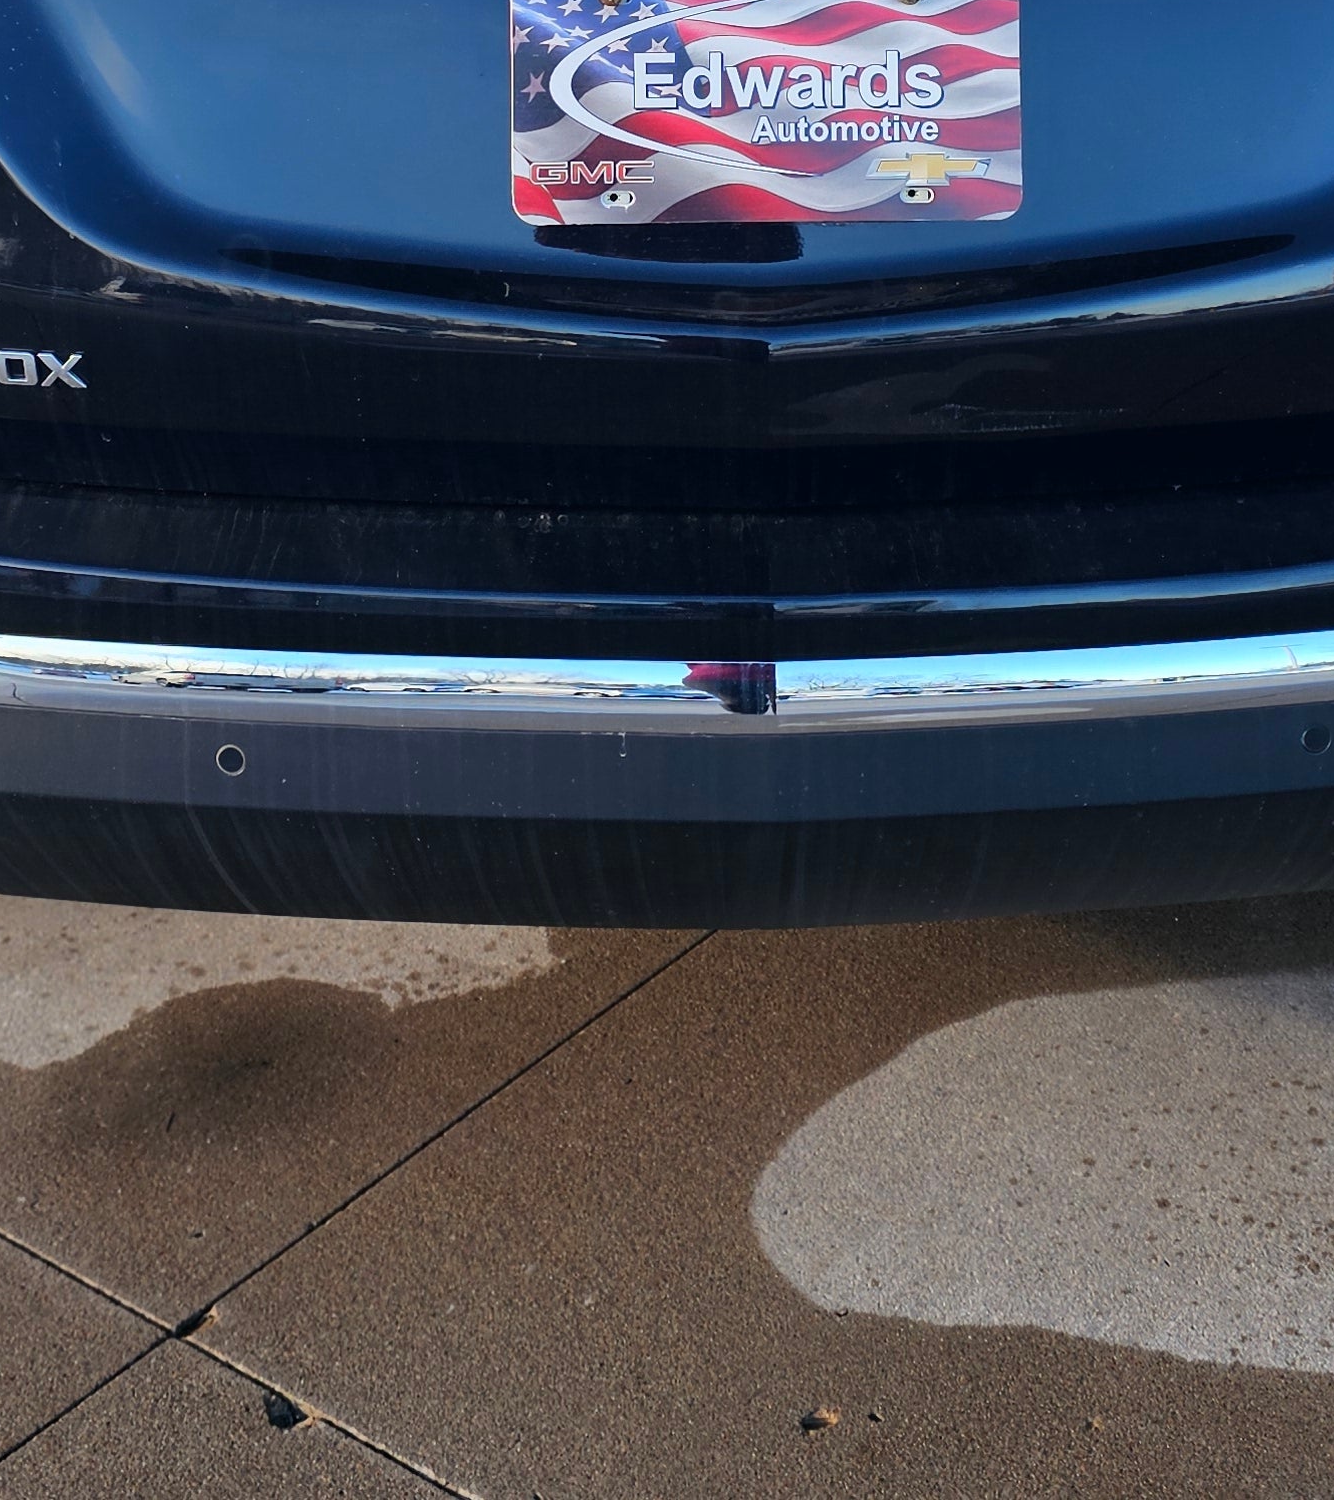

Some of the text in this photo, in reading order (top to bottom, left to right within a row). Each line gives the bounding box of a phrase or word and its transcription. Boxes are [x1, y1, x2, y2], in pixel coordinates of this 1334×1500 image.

[632, 49, 944, 110] Edwards
[751, 115, 940, 145] Automotive
[529, 159, 656, 186] GMC
